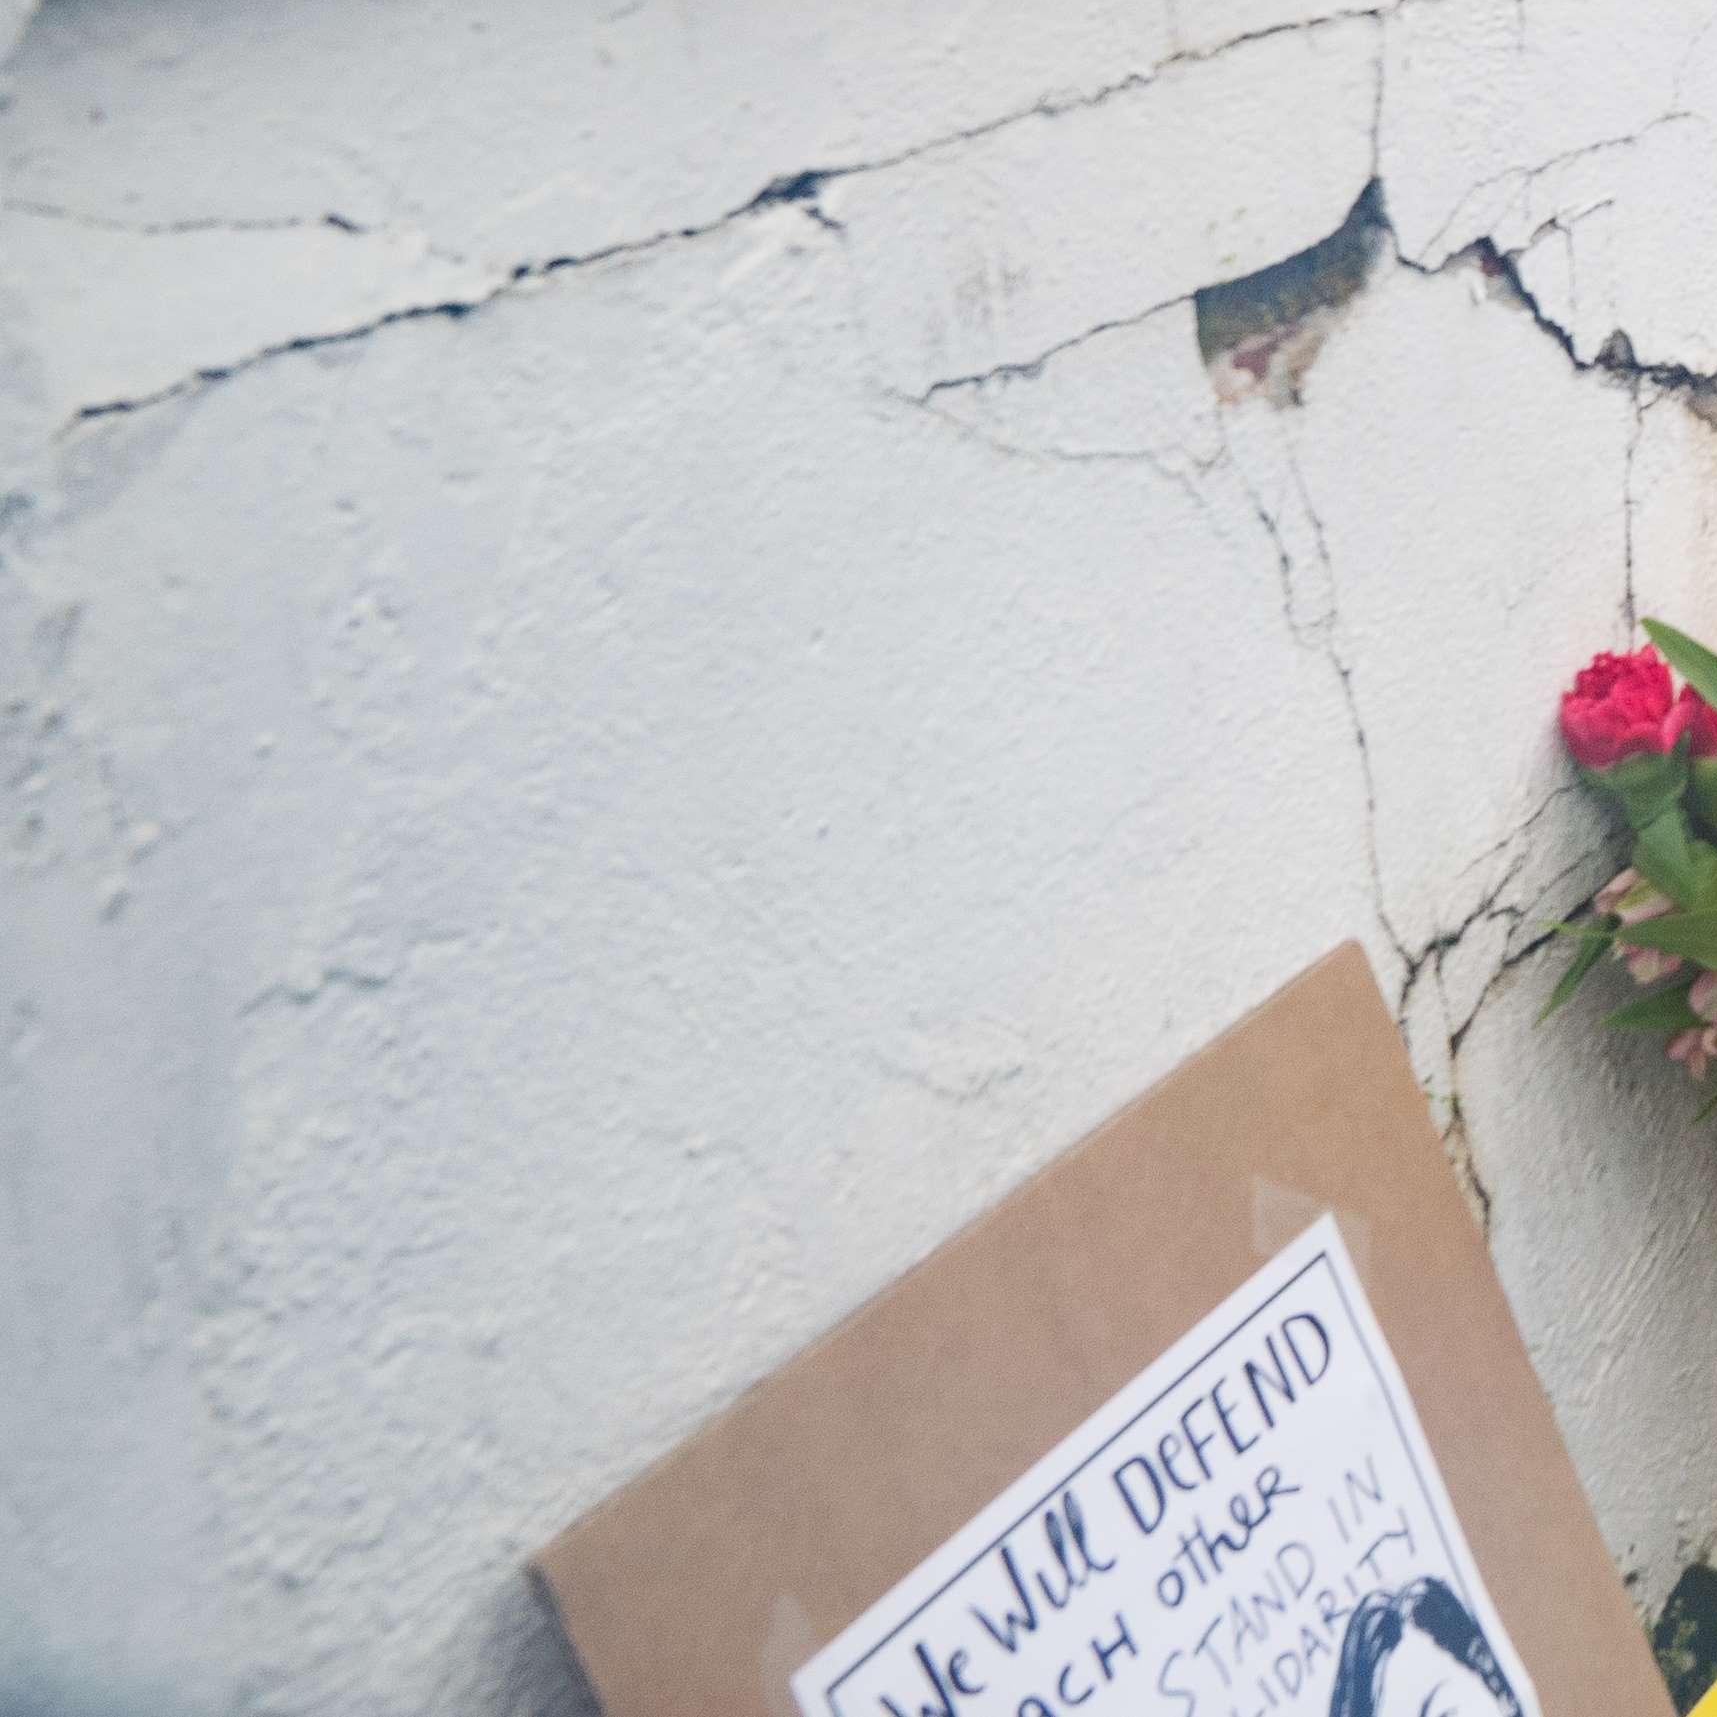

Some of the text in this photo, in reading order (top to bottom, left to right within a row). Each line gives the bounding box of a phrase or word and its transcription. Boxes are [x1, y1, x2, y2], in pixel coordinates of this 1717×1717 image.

[1157, 1453, 1386, 1717] STAND IN
[1230, 1507, 1416, 1717] IDARITY
